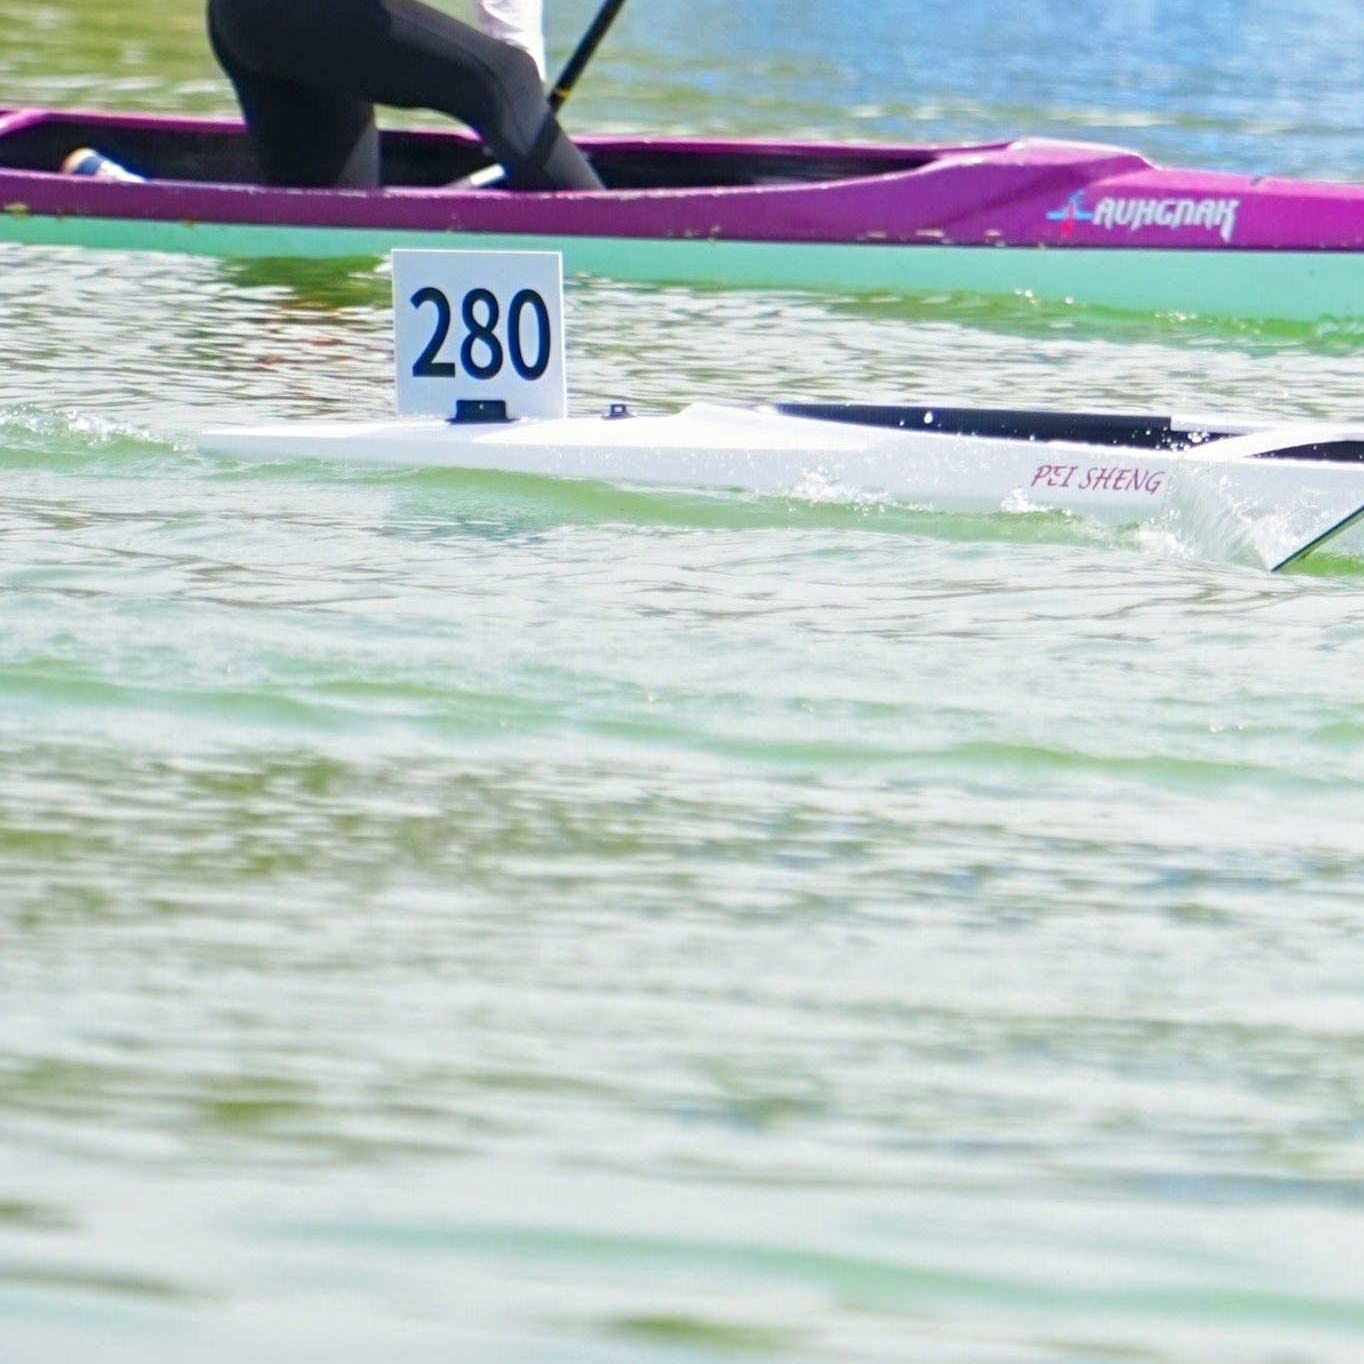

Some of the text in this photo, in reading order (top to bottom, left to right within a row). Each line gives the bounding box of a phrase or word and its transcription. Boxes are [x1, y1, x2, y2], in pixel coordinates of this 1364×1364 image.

[409, 286, 552, 381] 280
[1030, 464, 1166, 496] PEI SHENG
